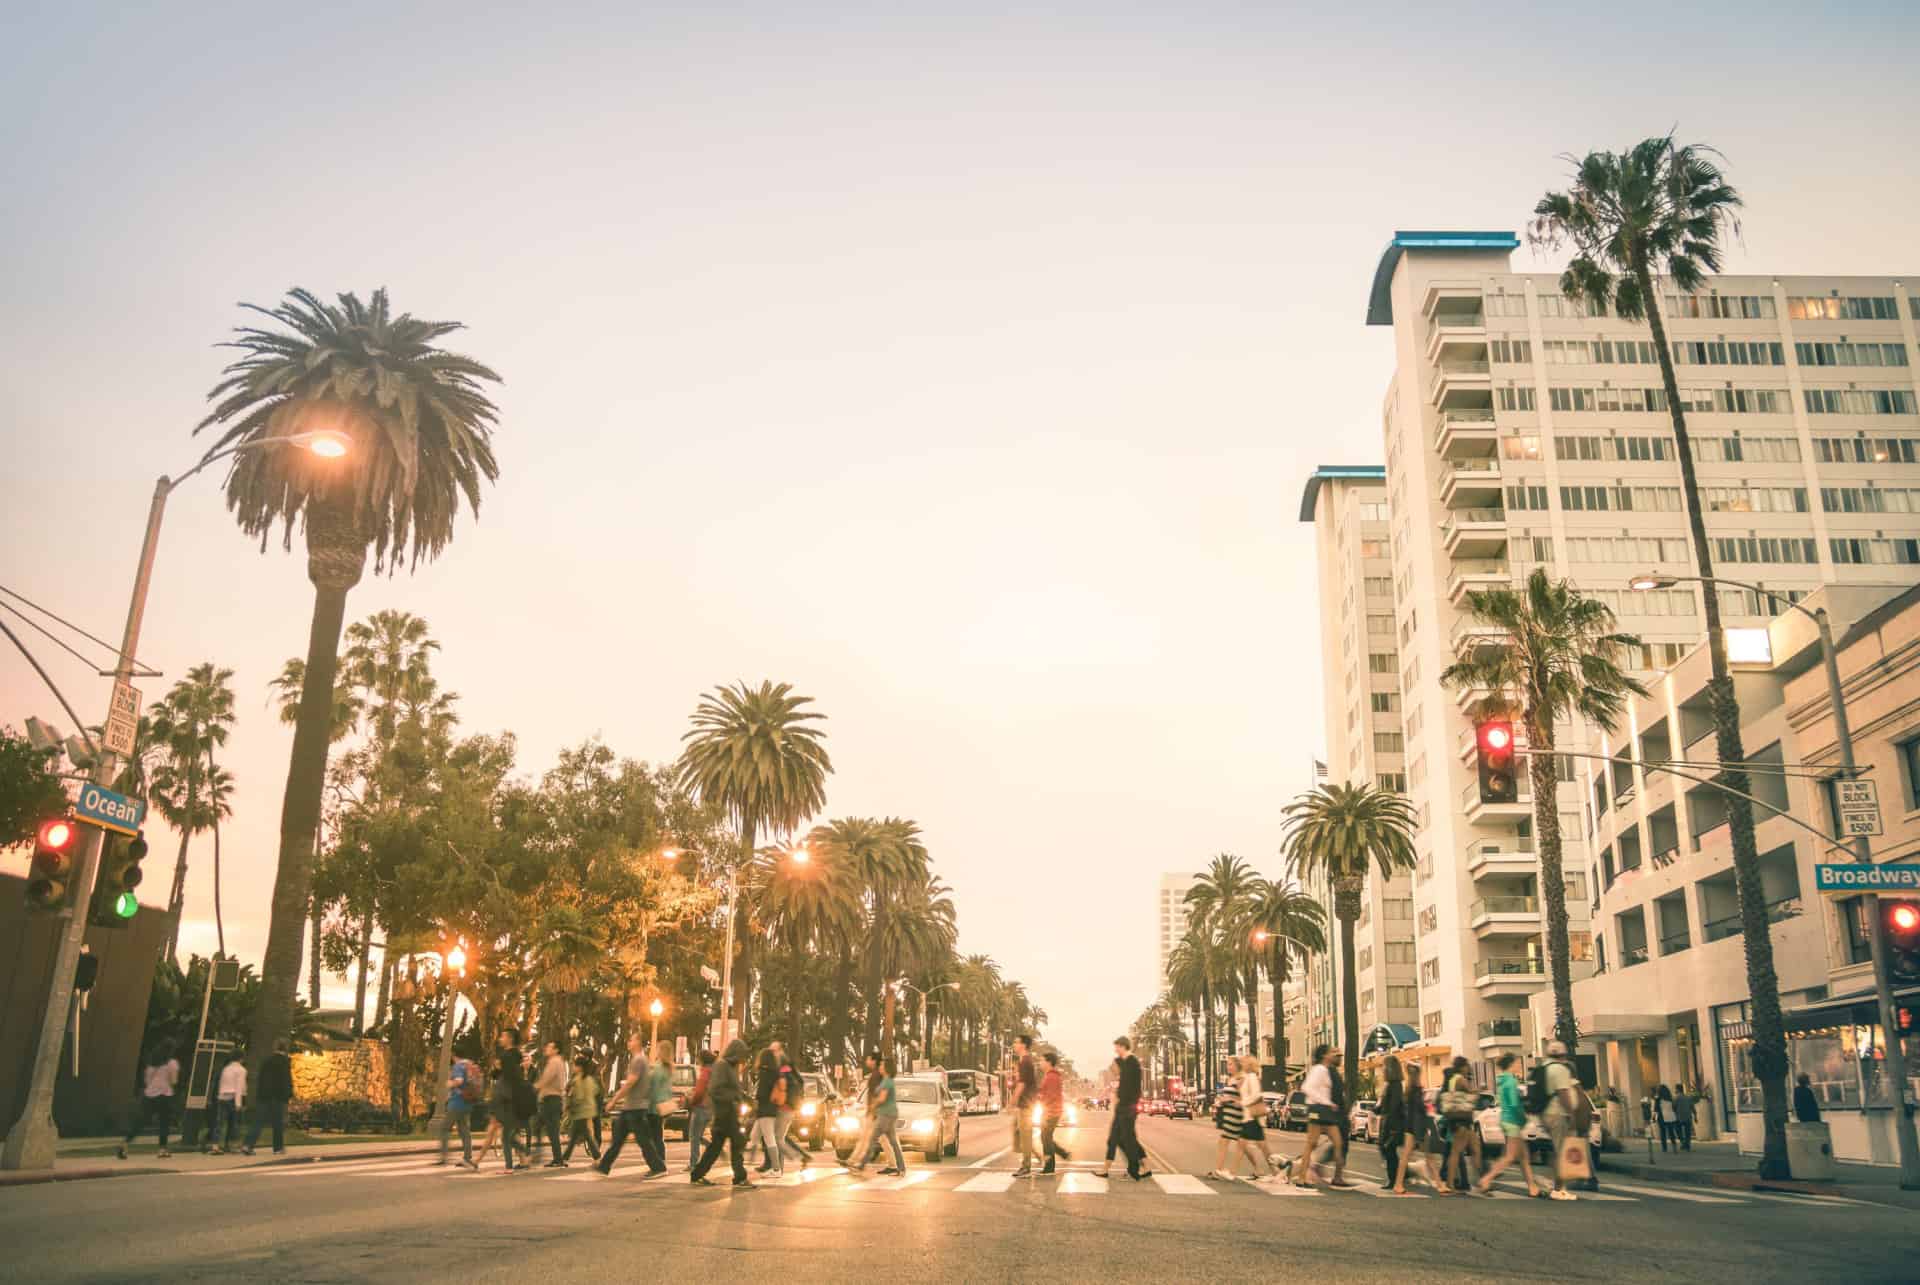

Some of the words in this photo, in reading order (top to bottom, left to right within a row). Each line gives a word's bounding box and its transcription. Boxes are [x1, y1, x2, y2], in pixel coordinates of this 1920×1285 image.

[1843, 792, 1871, 802] BLOCK
[85, 789, 137, 824] Ocean
[1850, 823, 1873, 833] $500
[1821, 866, 1920, 887] Broadway
